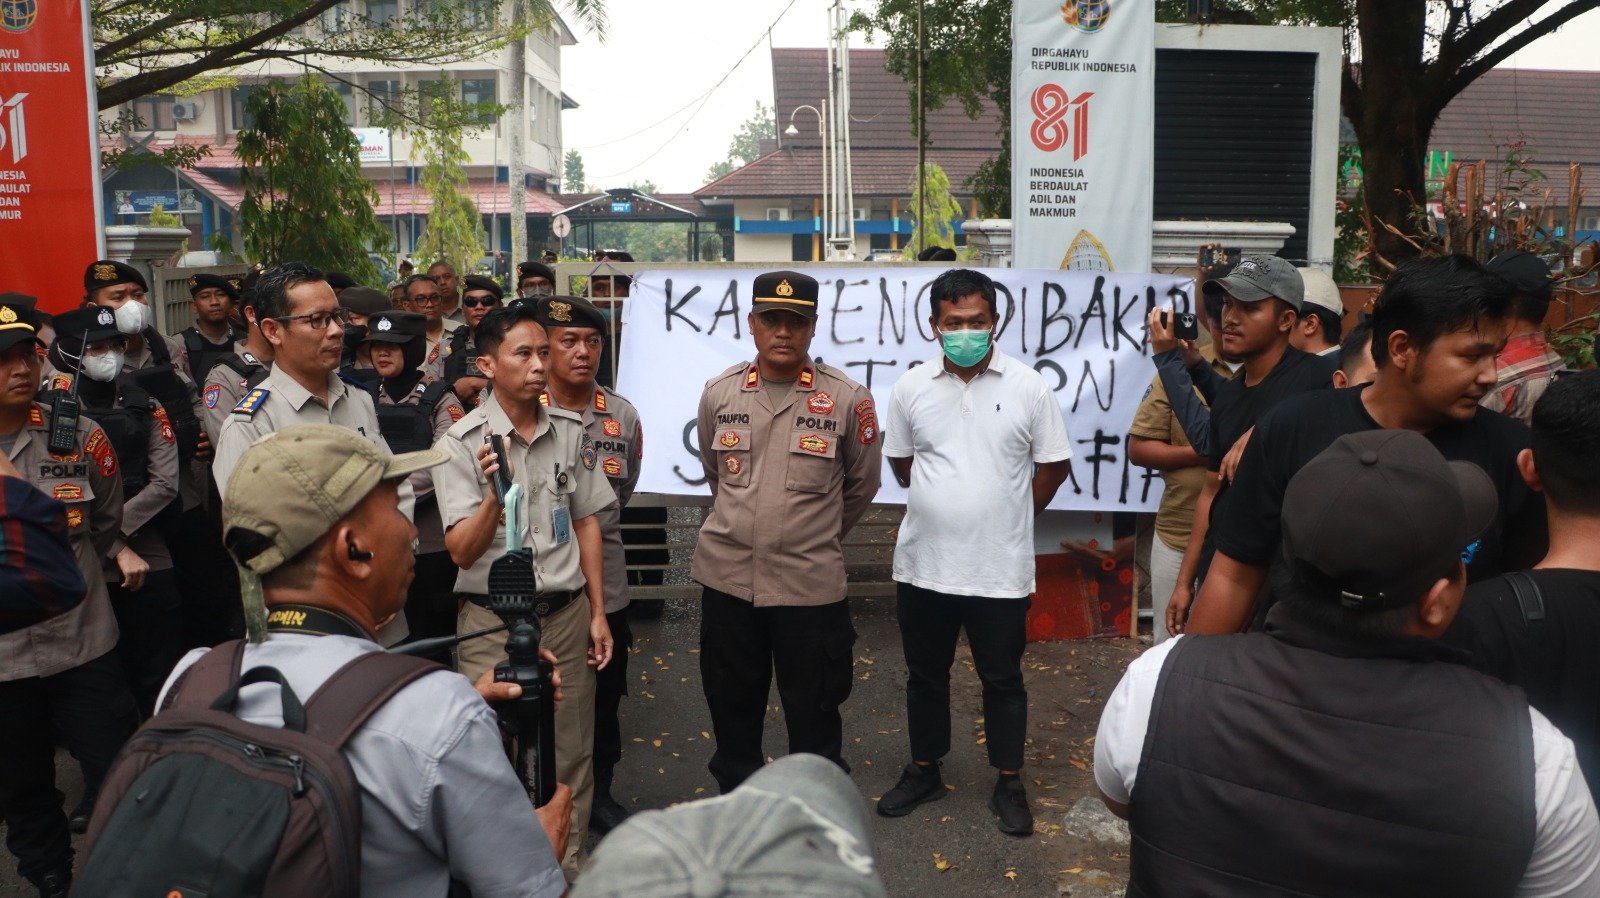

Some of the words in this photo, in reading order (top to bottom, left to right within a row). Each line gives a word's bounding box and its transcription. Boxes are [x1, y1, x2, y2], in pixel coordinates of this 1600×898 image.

[1031, 47, 1089, 59] DIRGAHAYU
[14, 62, 71, 73] INDONESIA
[1031, 61, 1080, 71] REPUBLIK
[1083, 62, 1137, 73] INDONESIA
[1030, 83, 1096, 162] 81
[1030, 168, 1084, 178] INDONESIA
[1030, 181, 1089, 191] BERDAULAT
[1029, 194, 1053, 204] ADIL
[1055, 194, 1076, 204] DAN
[1029, 207, 1076, 218] MAKMUR
[717, 413, 750, 425] TAUFIQ
[796, 416, 837, 431] POLRI
[595, 440, 626, 453] POLRI
[40, 464, 87, 478] POLRI
